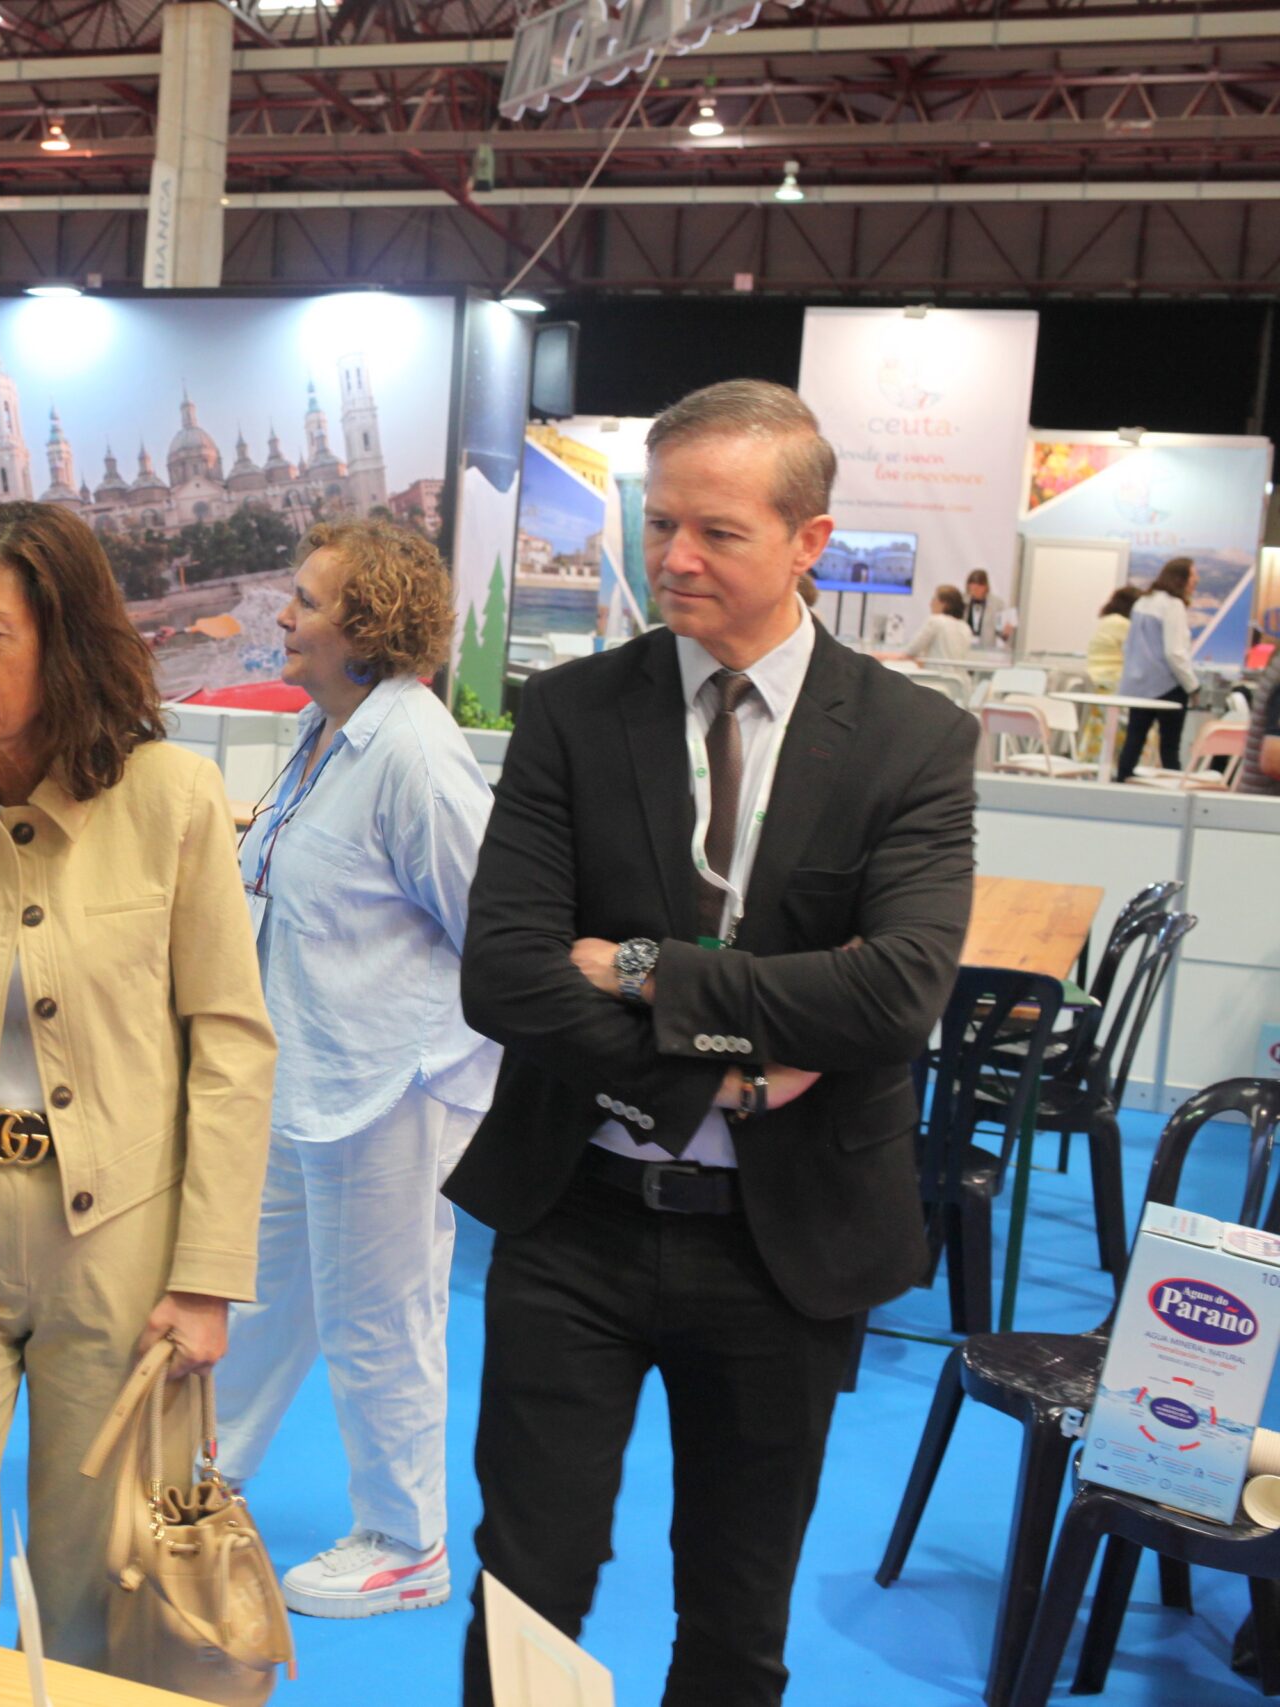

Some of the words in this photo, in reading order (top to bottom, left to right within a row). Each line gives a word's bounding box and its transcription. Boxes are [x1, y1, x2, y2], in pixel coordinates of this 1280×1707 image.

[154, 179, 172, 287] BANCA
[868, 416, 952, 437] ceuta
[1157, 1286, 1255, 1336] Paraño
[1183, 1287, 1215, 1302] Aguas
[1144, 1331, 1169, 1343] AGUA
[1170, 1337, 1206, 1354] MINERAL
[1208, 1348, 1246, 1365] NATURAL
